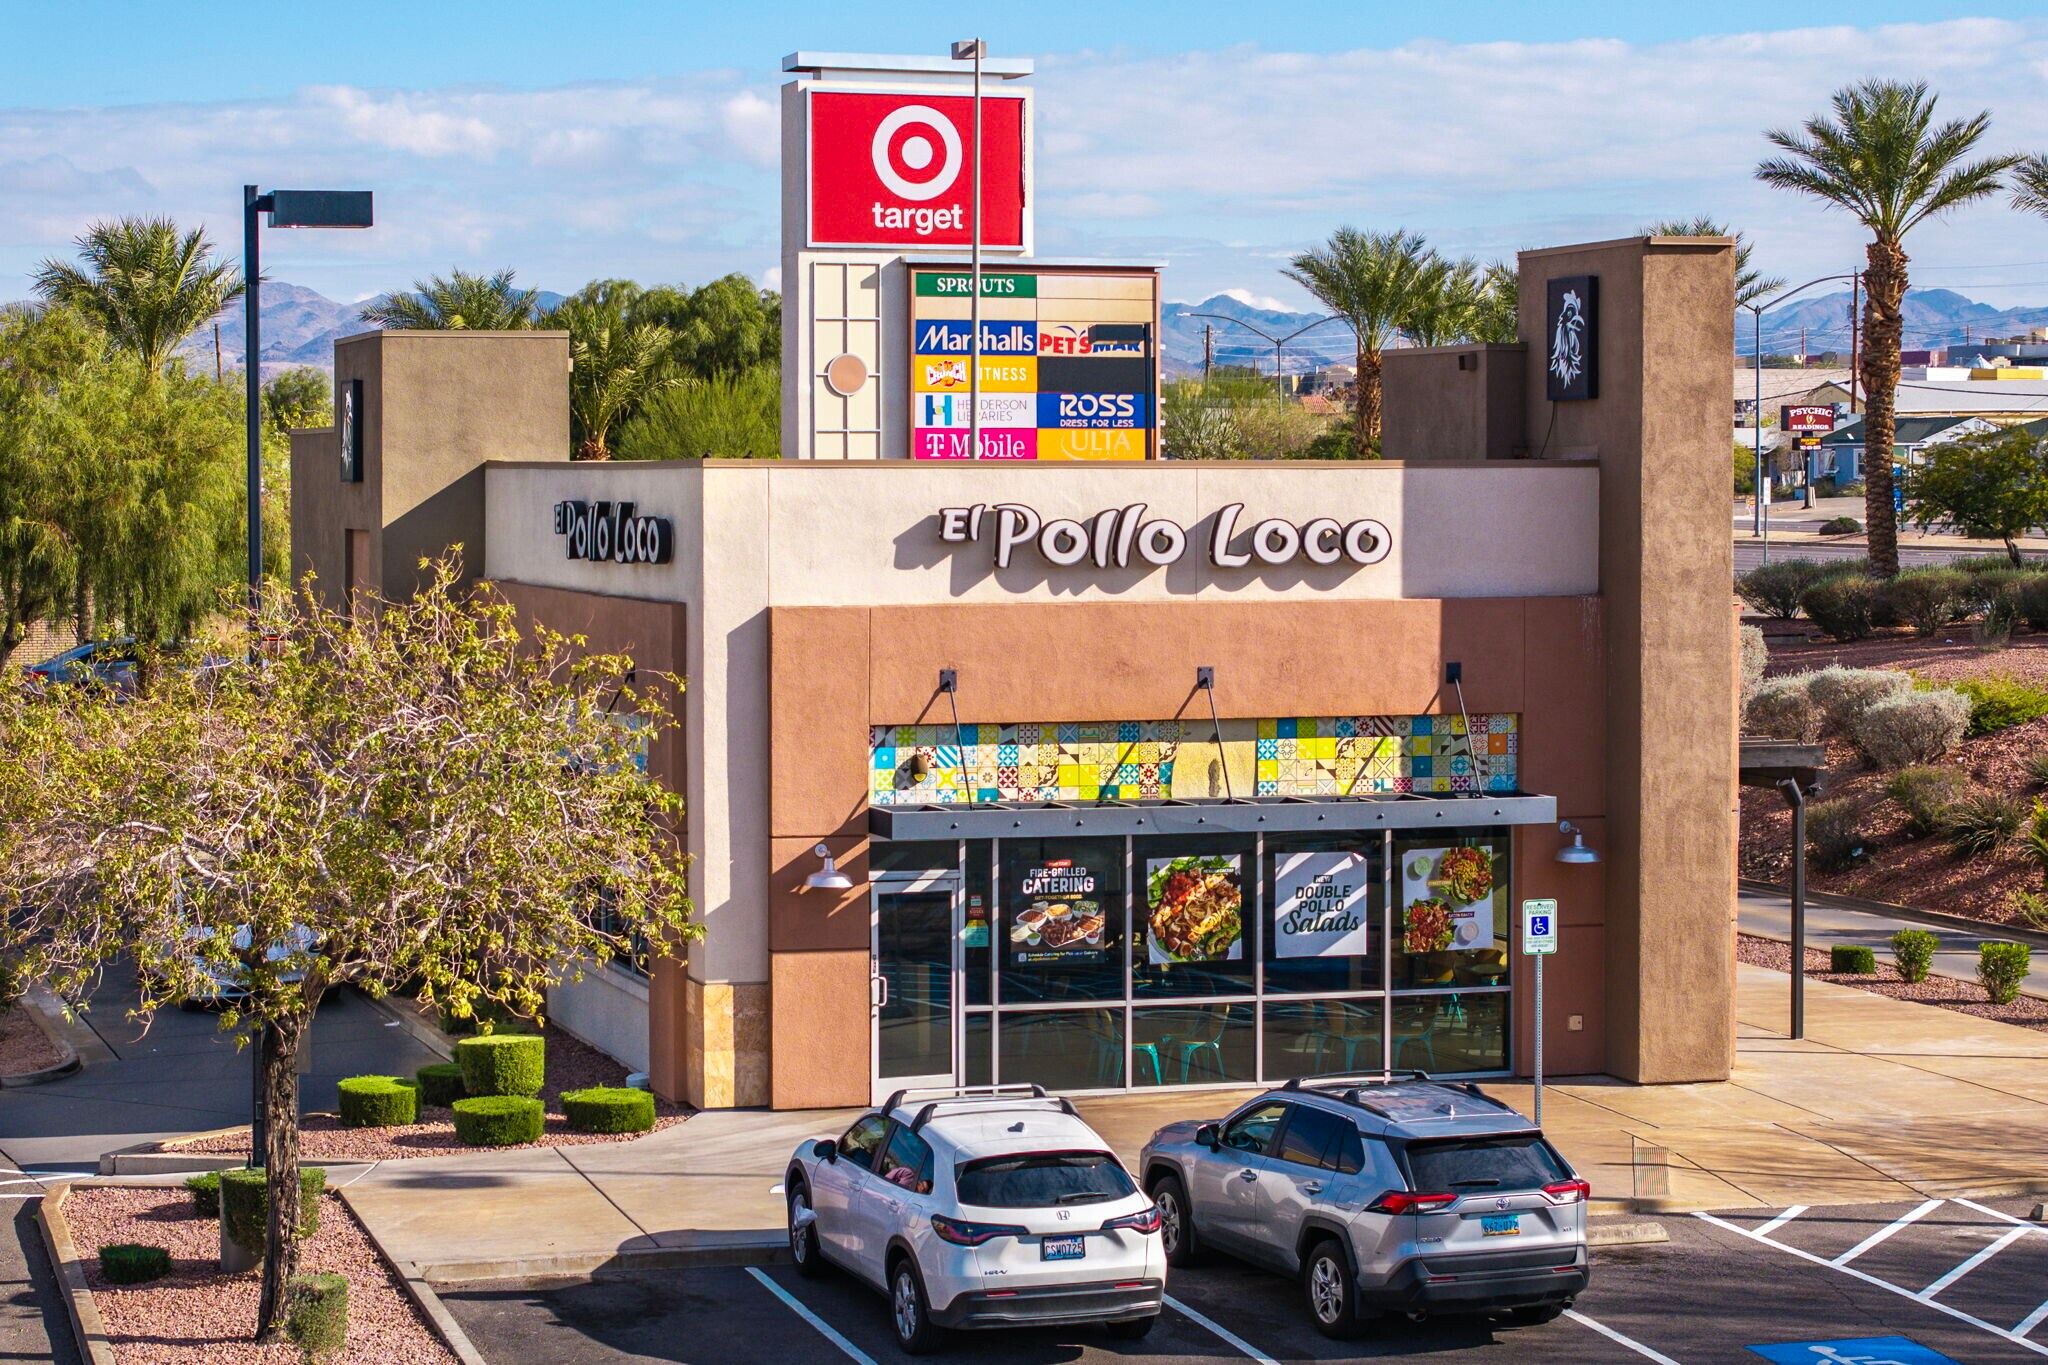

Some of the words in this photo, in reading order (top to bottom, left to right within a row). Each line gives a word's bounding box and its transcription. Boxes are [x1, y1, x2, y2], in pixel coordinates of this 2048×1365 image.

[872, 202, 963, 235] target
[919, 325, 1034, 351] Marhalls
[979, 367, 1027, 381] ITNESS
[957, 399, 1027, 410] HEDERSON
[1060, 394, 1134, 417] ROSS
[1790, 407, 1833, 417] PSYCHIC
[1060, 419, 1088, 427] DRESS
[1091, 419, 1109, 427] FOR
[1112, 419, 1134, 427] LESS
[949, 433, 1026, 458] Mbile
[1071, 430, 1131, 451] ULTA
[614, 502, 666, 564] Loco
[992, 503, 1188, 569] Pollo
[1209, 502, 1393, 568] Loco
[1030, 867, 1087, 878] FIRE-GRILLED
[1022, 877, 1095, 894] CATERING
[1295, 885, 1352, 899] DOUBLE
[1299, 899, 1345, 912] POLLO
[1283, 909, 1359, 935] Salads
